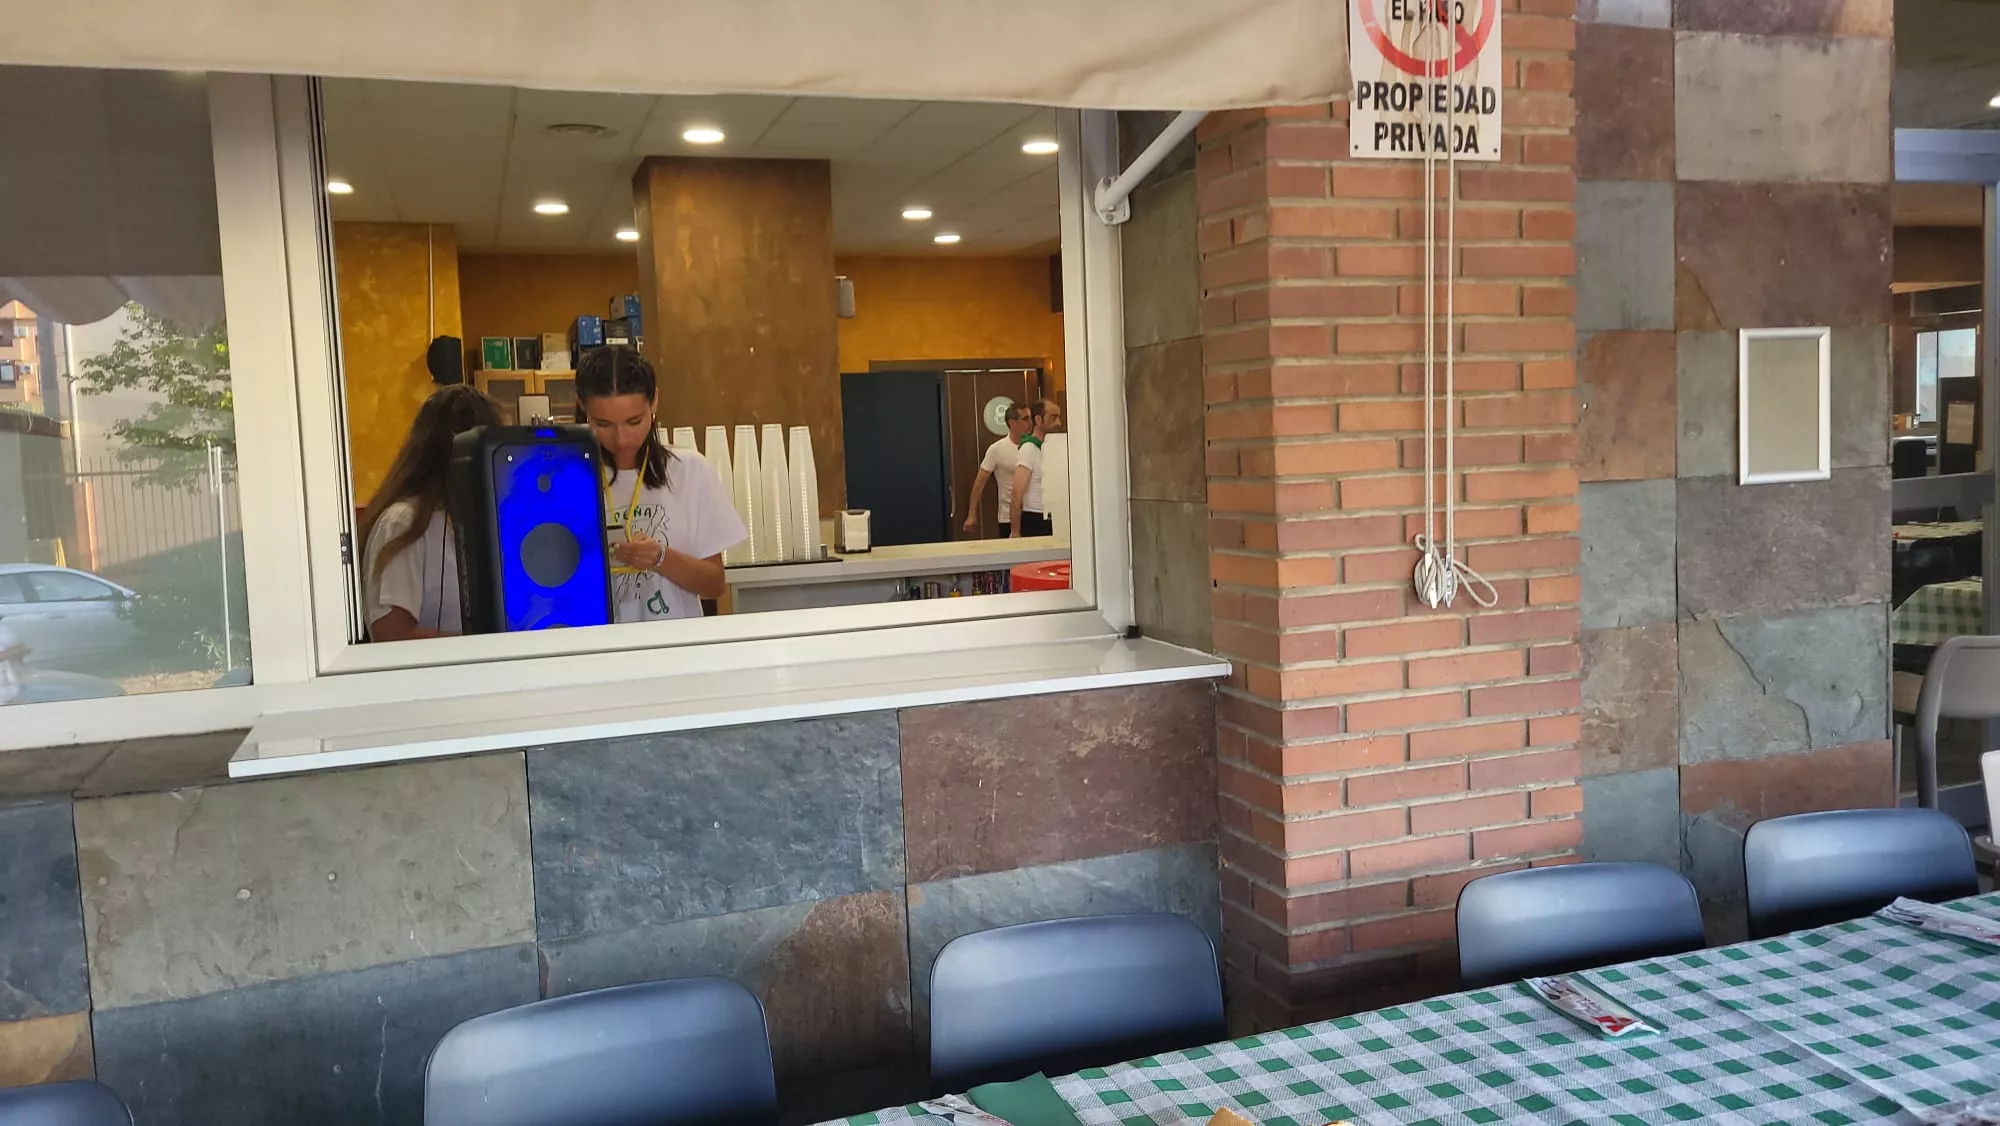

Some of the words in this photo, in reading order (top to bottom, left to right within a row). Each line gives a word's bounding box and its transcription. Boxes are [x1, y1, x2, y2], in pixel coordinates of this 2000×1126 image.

[1392, 0, 1413, 20] EL
[1357, 80, 1496, 114] PROPIEDAD
[1374, 122, 1479, 153] PRIVADA
